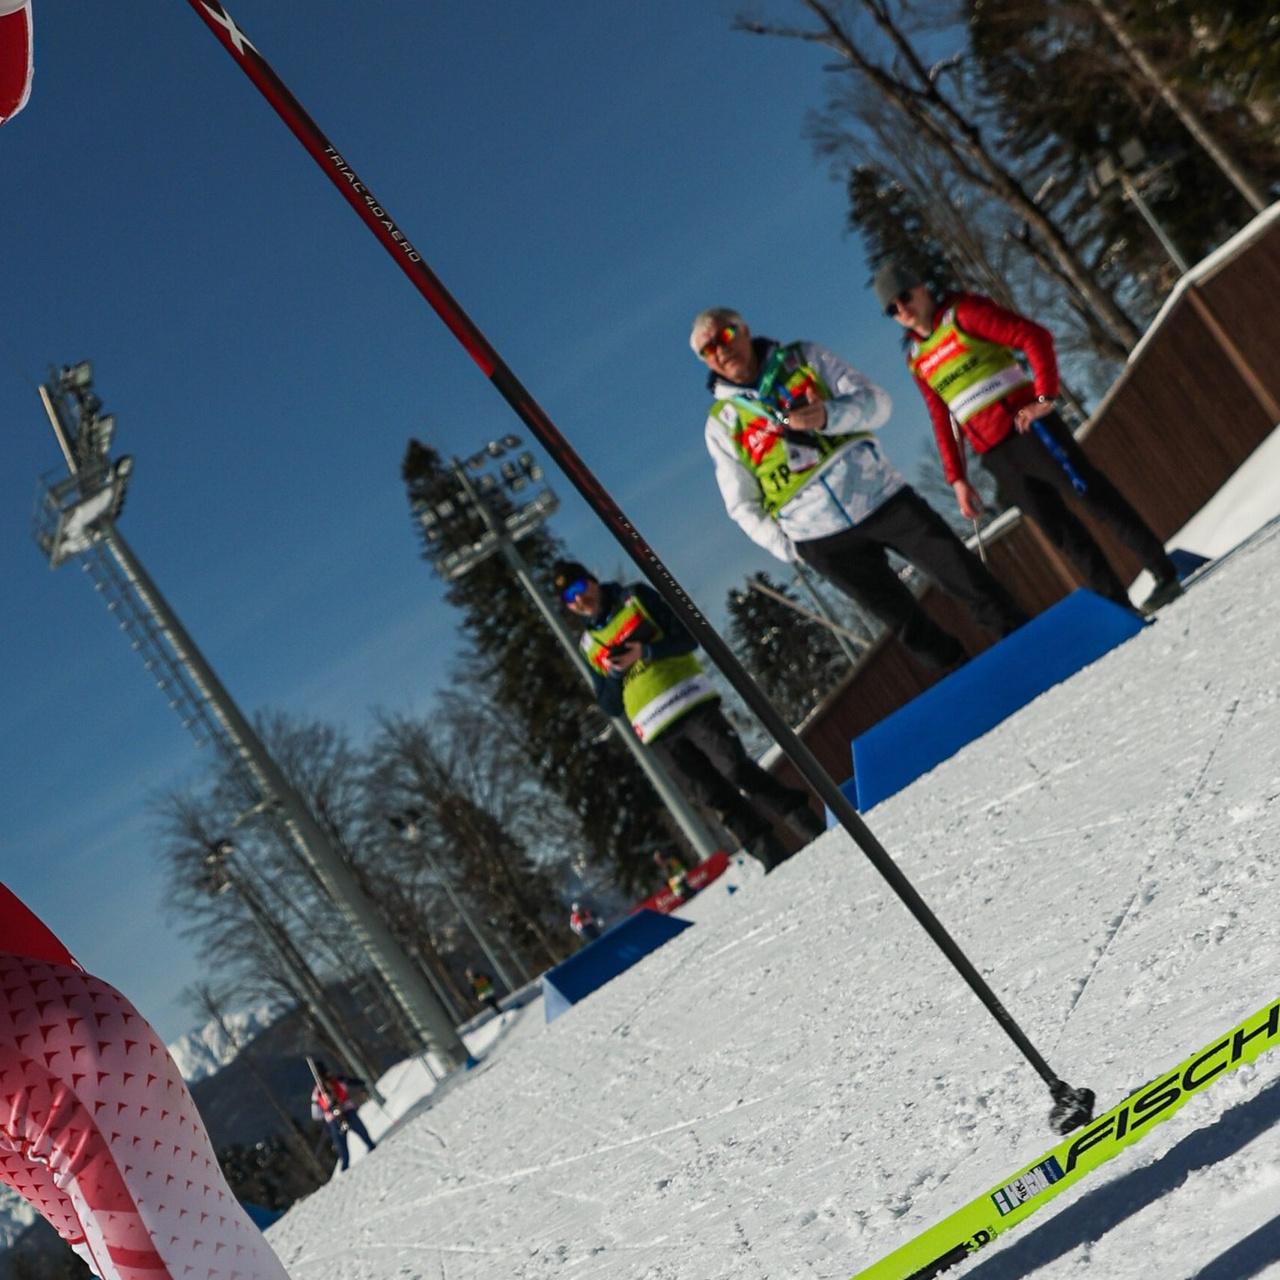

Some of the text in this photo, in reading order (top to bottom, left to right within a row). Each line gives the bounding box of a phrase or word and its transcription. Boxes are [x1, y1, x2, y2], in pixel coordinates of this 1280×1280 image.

[325, 145, 420, 262] TRIAC 4.0 AERO
